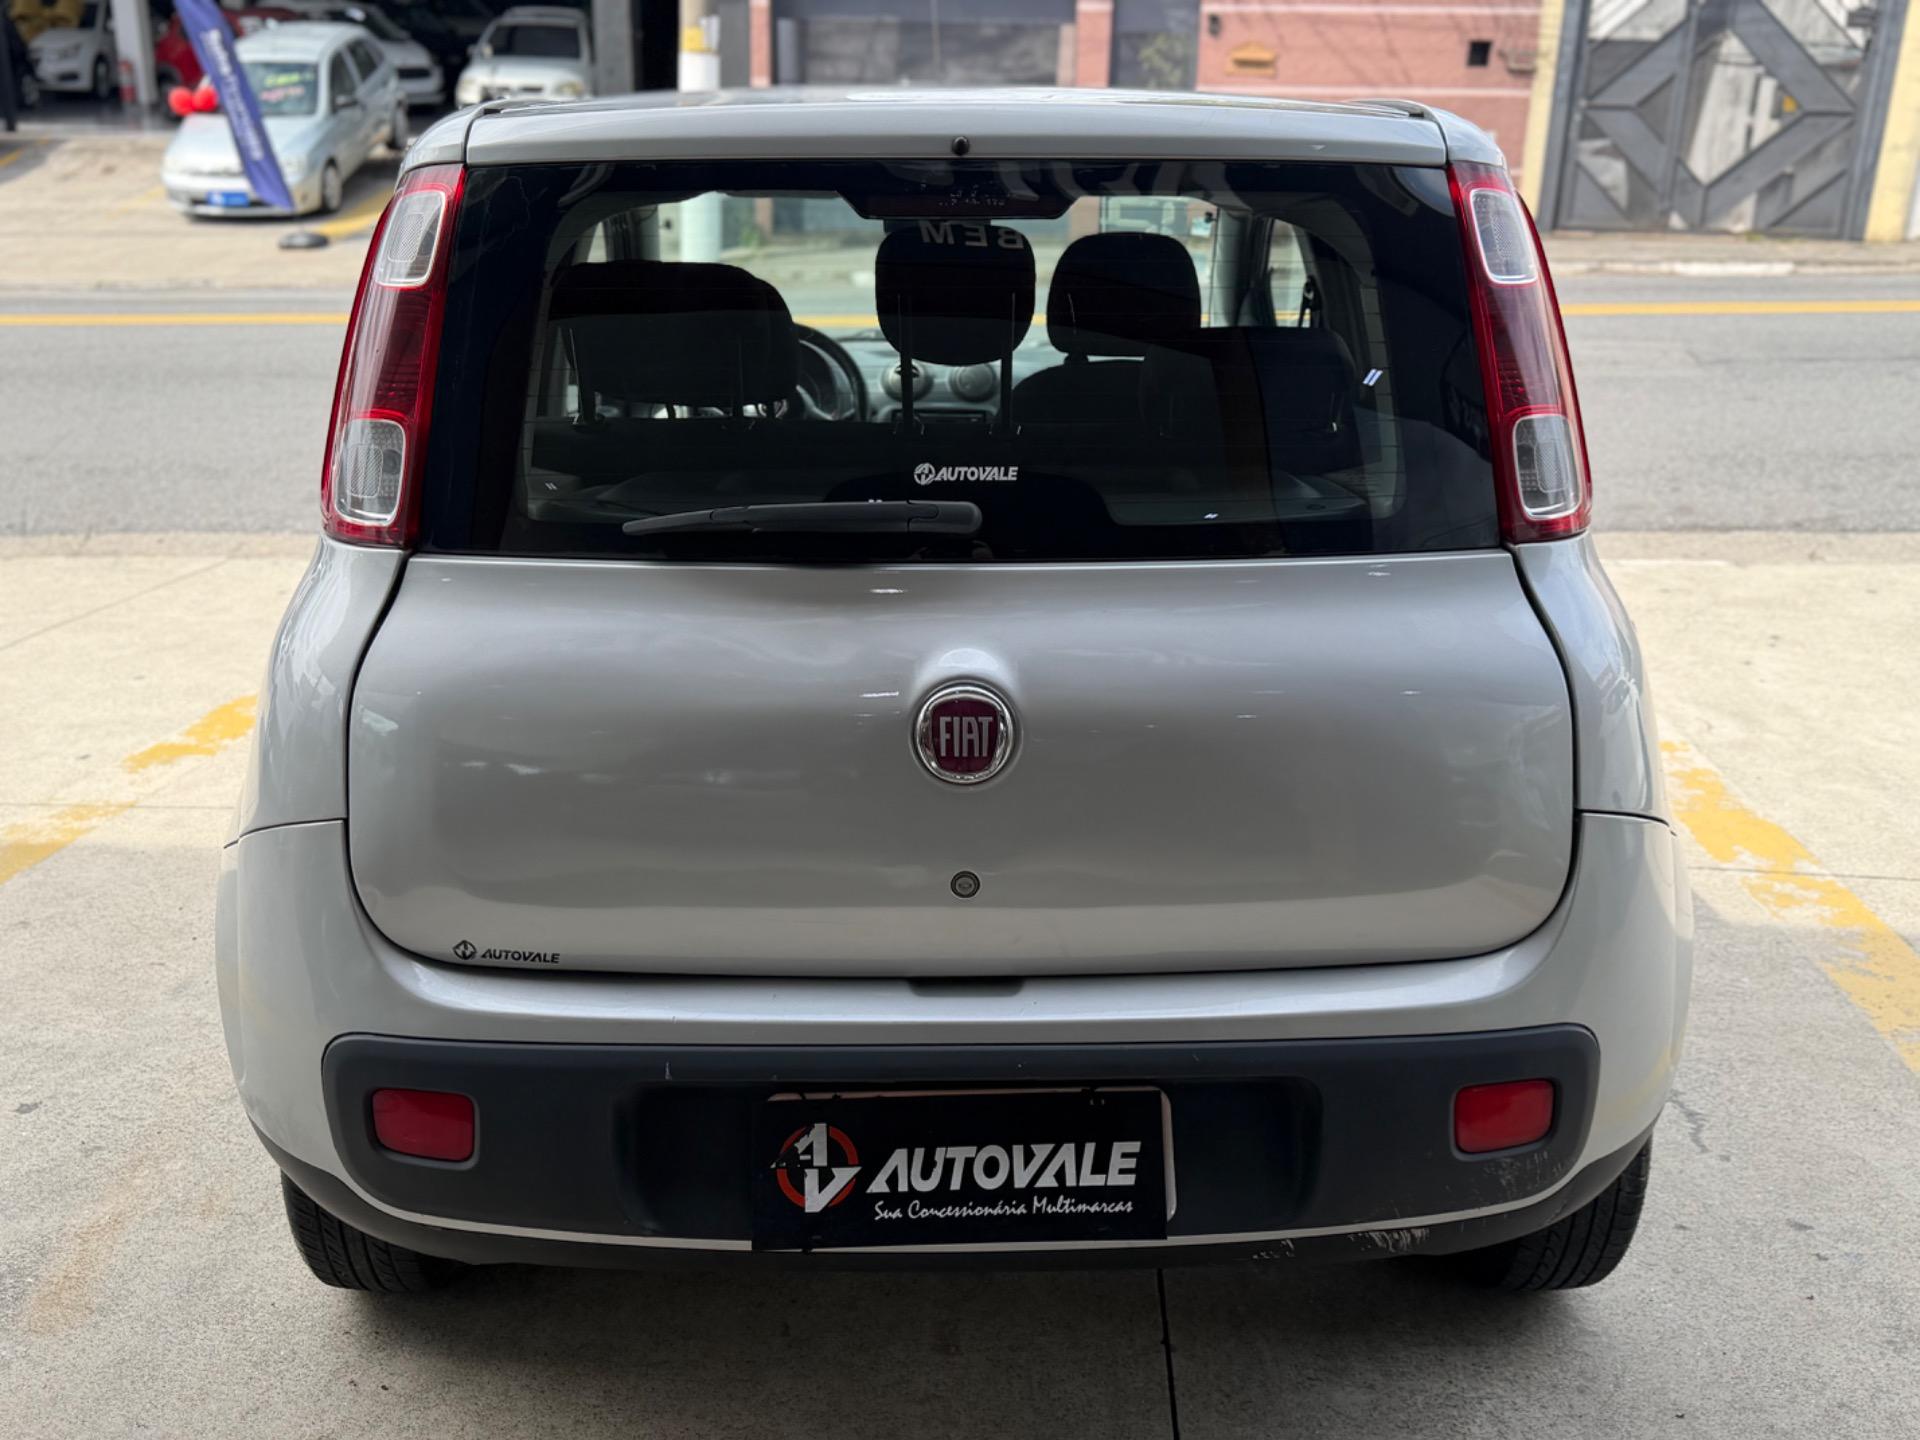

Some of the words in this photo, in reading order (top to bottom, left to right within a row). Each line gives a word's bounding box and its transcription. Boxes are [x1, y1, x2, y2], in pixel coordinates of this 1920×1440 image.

[936, 466, 1018, 480] AUTOVALE
[939, 716, 993, 758] FIAT
[481, 949, 560, 963] AUTOVALE
[866, 1141, 1141, 1193] AUTOVALE
[874, 1200, 903, 1221] Sua
[908, 1199, 1028, 1219] Concessionária
[1032, 1195, 1134, 1215] Multimarcas
